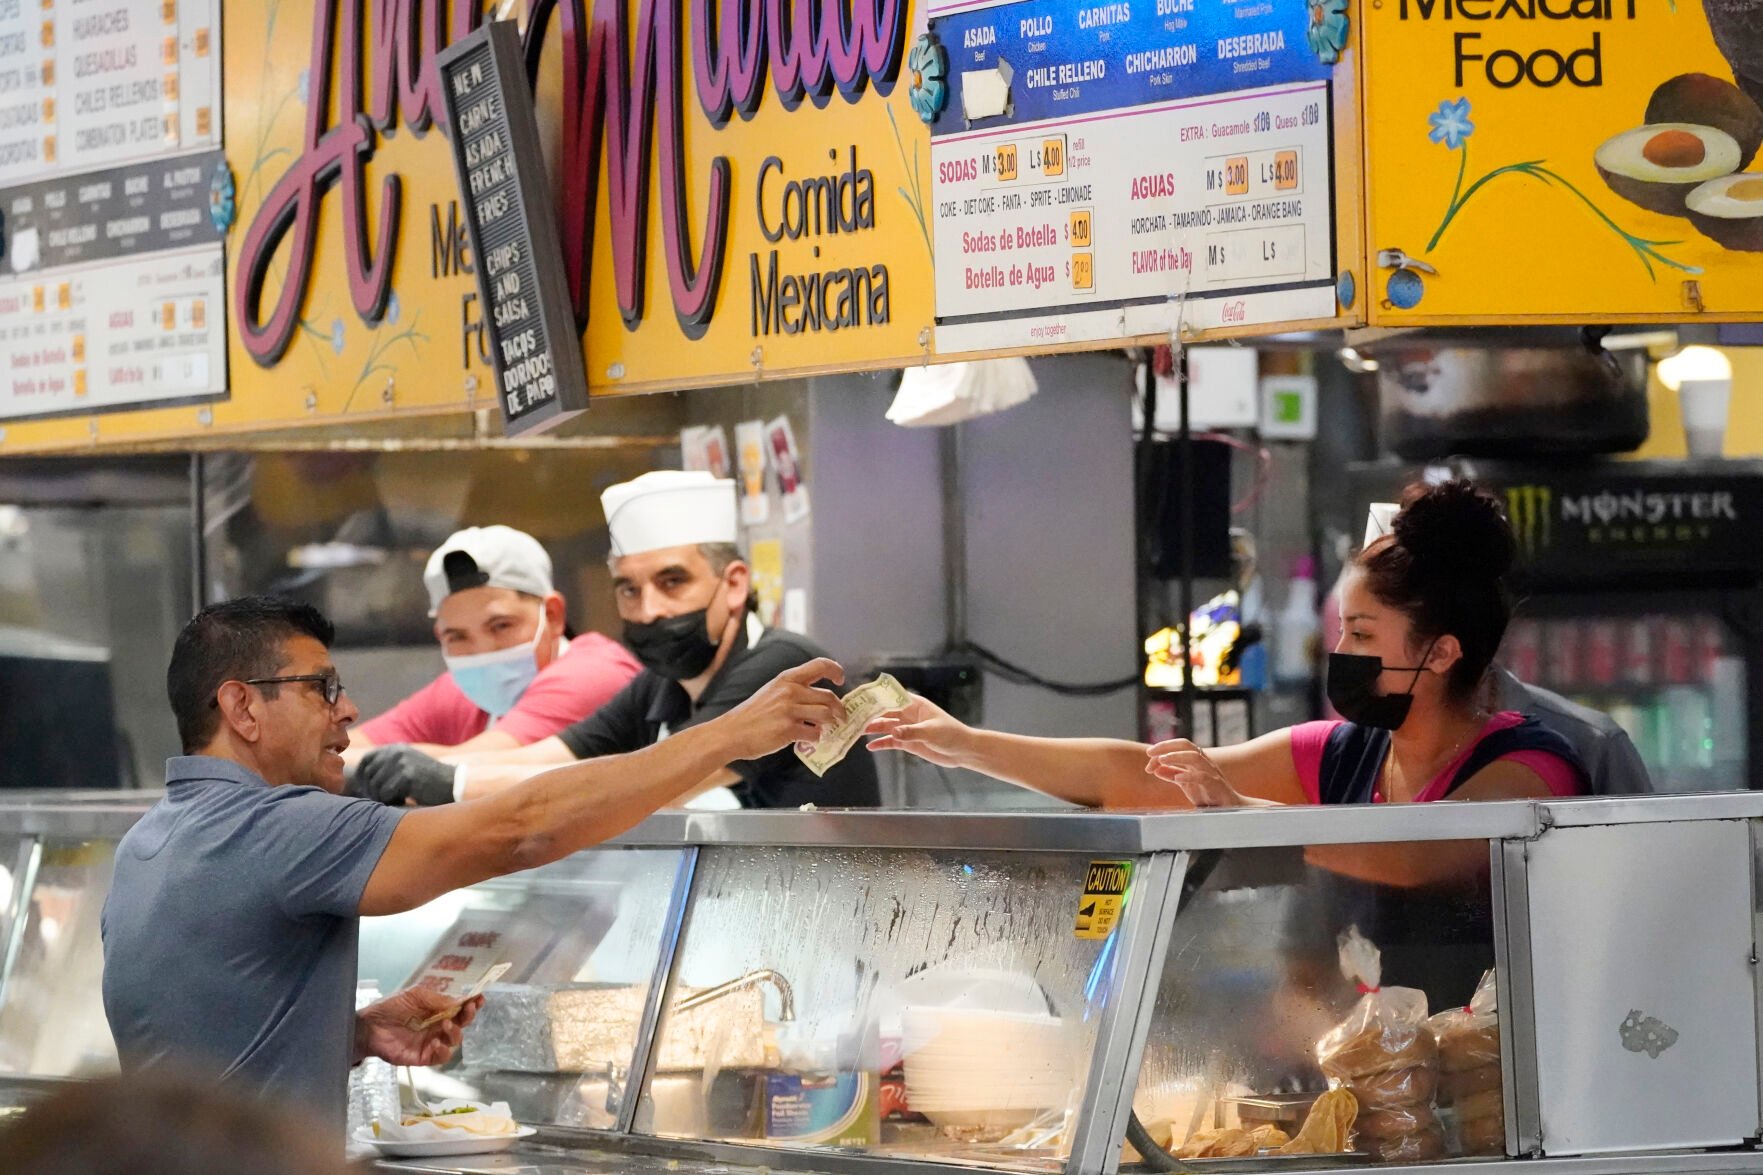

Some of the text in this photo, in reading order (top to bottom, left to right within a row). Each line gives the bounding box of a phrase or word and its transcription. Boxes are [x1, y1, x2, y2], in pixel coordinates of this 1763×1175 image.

[1079, 2, 1130, 30] CARNITAS
[1157, 0, 1194, 16] BUCHE
[73, 8, 129, 40] HUARACHES
[964, 26, 996, 48] ASADA
[1020, 16, 1053, 38] POLLO
[974, 50, 986, 62] Beef
[1028, 42, 1047, 53] Chicken
[1126, 44, 1197, 74] CHICHARRON
[1218, 30, 1285, 59] DESEBRADA
[74, 45, 136, 78] QUESADILLAS
[1027, 59, 1105, 89] CHILE RELLENO
[1454, 32, 1603, 89] Food
[1149, 75, 1161, 87] Pork
[75, 88, 106, 115] CHILES
[460, 97, 498, 134] CARNE
[1212, 120, 1250, 138] Guacamole
[1275, 115, 1298, 130] Queso
[466, 131, 502, 167] ASADA
[1077, 154, 1091, 170] price
[470, 155, 513, 194] FRENCH
[939, 158, 977, 184] SODAS
[983, 155, 990, 175] M
[1030, 150, 1036, 169] L
[1131, 173, 1175, 200] AGUAS
[1206, 170, 1215, 191] M
[1261, 163, 1268, 184] L
[476, 191, 509, 225] FRIES
[756, 145, 875, 243] Comida
[940, 185, 1092, 218] COKE DIET COKE FANTA SPRITE LEMONADE
[1131, 200, 1302, 235] HORCHATA TAMARINDO JAMAICA ORANGE BANG
[962, 230, 996, 254] Sodas
[1000, 229, 1013, 251] de
[1016, 223, 1057, 249] Botella
[486, 242, 520, 275] CHIPS
[1132, 249, 1158, 275] FLAVOR
[1159, 248, 1166, 271] of
[1167, 248, 1178, 270] the
[1180, 247, 1193, 274] Day
[1208, 245, 1217, 265] M
[1263, 240, 1269, 261] L
[497, 273, 520, 301] AND
[965, 265, 1005, 289] Botella
[1009, 263, 1022, 285] de
[1026, 262, 1055, 290] Agua
[750, 246, 890, 338] Mexicana
[494, 299, 529, 327] SALSA
[1030, 322, 1066, 338] enjoy together
[501, 329, 536, 365] TACOS
[507, 391, 523, 415] DE
[1561, 490, 1737, 524] MONSTER
[1088, 867, 1127, 891] CAUTION
